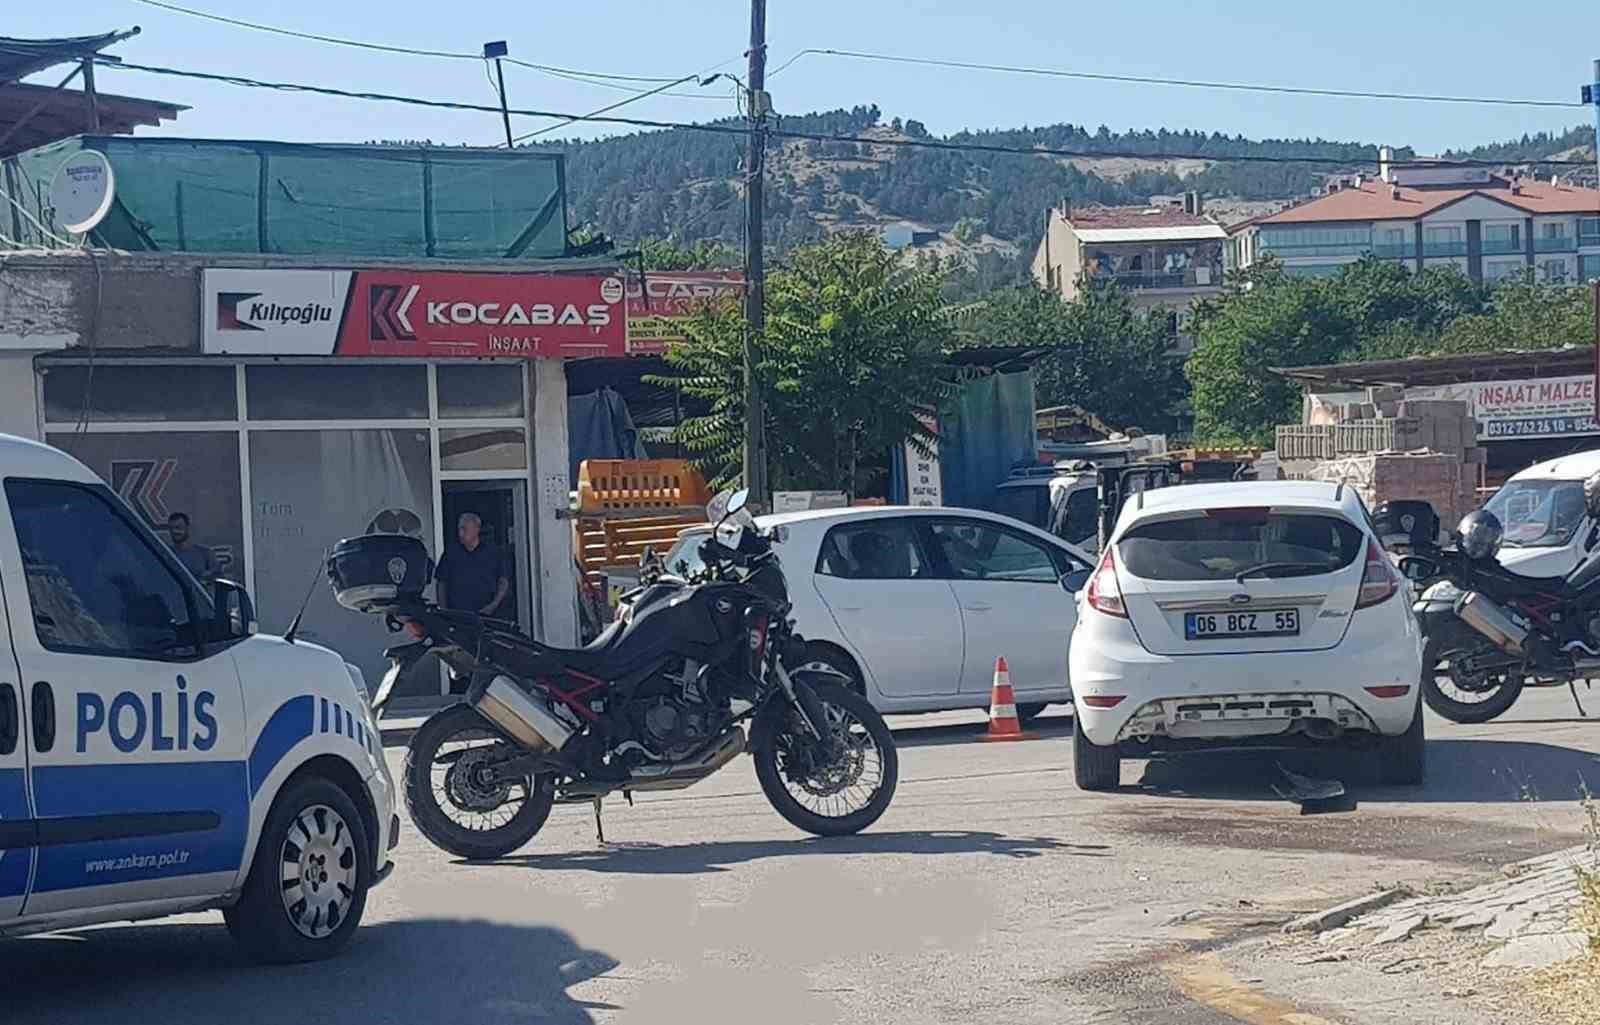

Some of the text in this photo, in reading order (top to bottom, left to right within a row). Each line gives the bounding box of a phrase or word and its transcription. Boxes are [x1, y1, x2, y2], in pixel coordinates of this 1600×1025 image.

[249, 303, 332, 325] Kılıçoğlu
[427, 302, 610, 334] KOCABAŞ
[1489, 420, 1515, 435] 0312
[1516, 420, 1536, 434] 762
[1537, 419, 1551, 433] 26
[1552, 418, 1566, 432] 10
[1197, 615, 1217, 633] 06
[1227, 614, 1257, 632] BCZ
[1275, 612, 1296, 630] 55
[76, 674, 218, 754] POLİS
[85, 849, 190, 873] www.ankara.pol.tr
